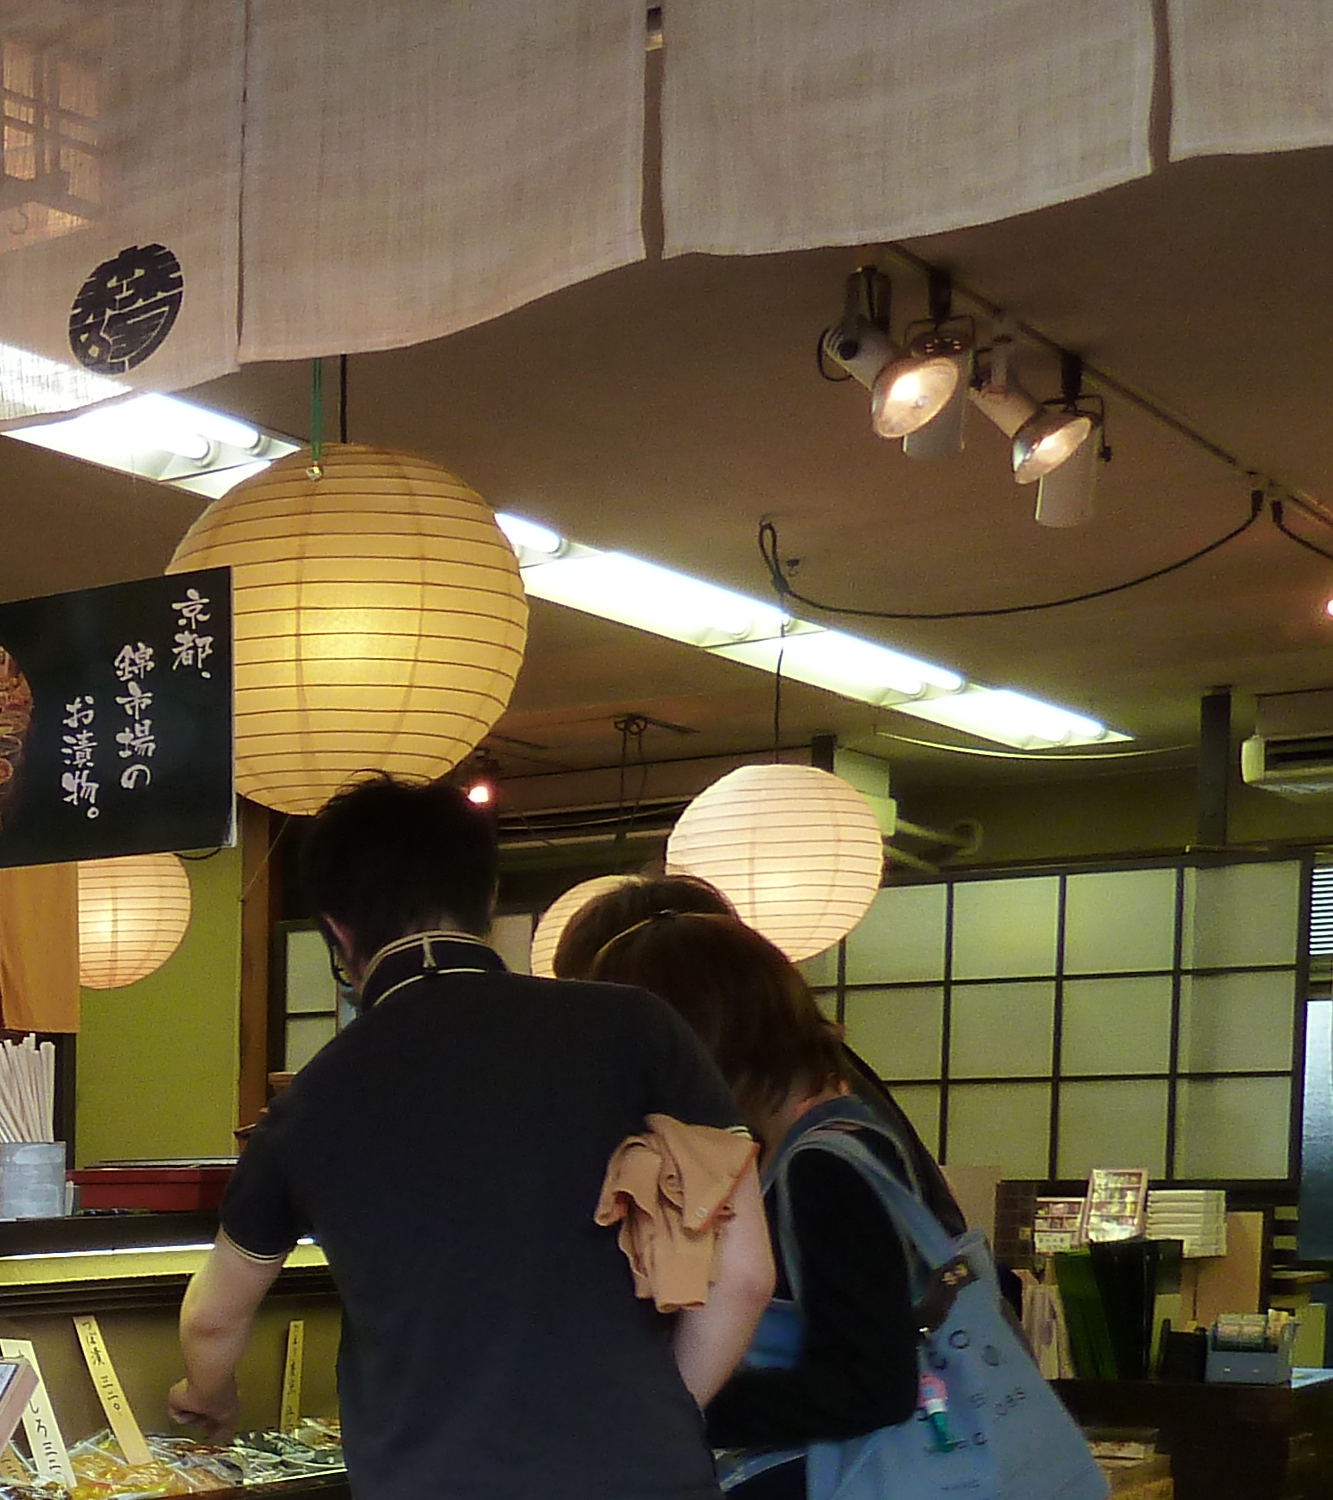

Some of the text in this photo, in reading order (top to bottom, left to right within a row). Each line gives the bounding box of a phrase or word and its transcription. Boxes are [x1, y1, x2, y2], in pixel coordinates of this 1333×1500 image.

[61, 695, 100, 820] お漬物。
[113, 642, 157, 790] 錦市場の
